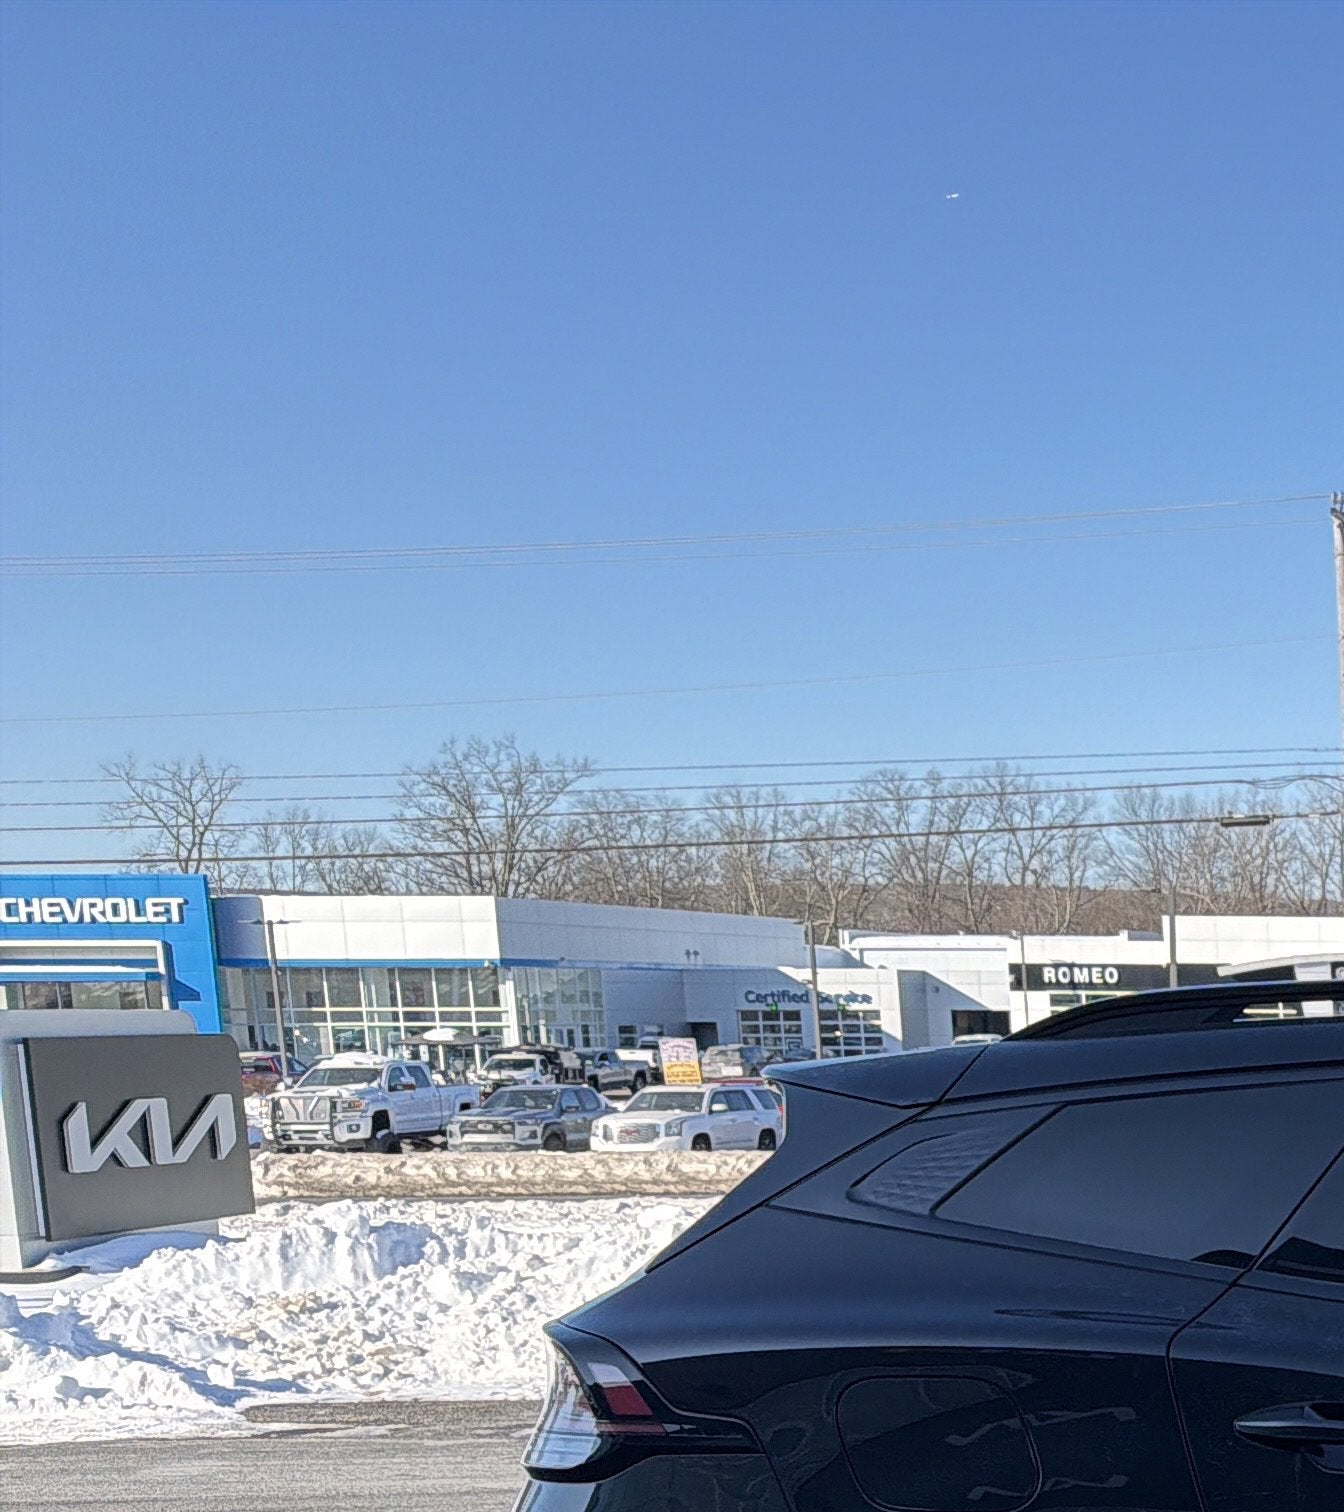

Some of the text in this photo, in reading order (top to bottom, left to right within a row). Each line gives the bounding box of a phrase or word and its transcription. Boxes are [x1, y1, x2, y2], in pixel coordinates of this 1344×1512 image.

[0, 897, 186, 923] CHEVROLET
[1042, 966, 1119, 984] ROMEO
[744, 989, 809, 1004] Certified
[62, 1093, 237, 1174] KIA
